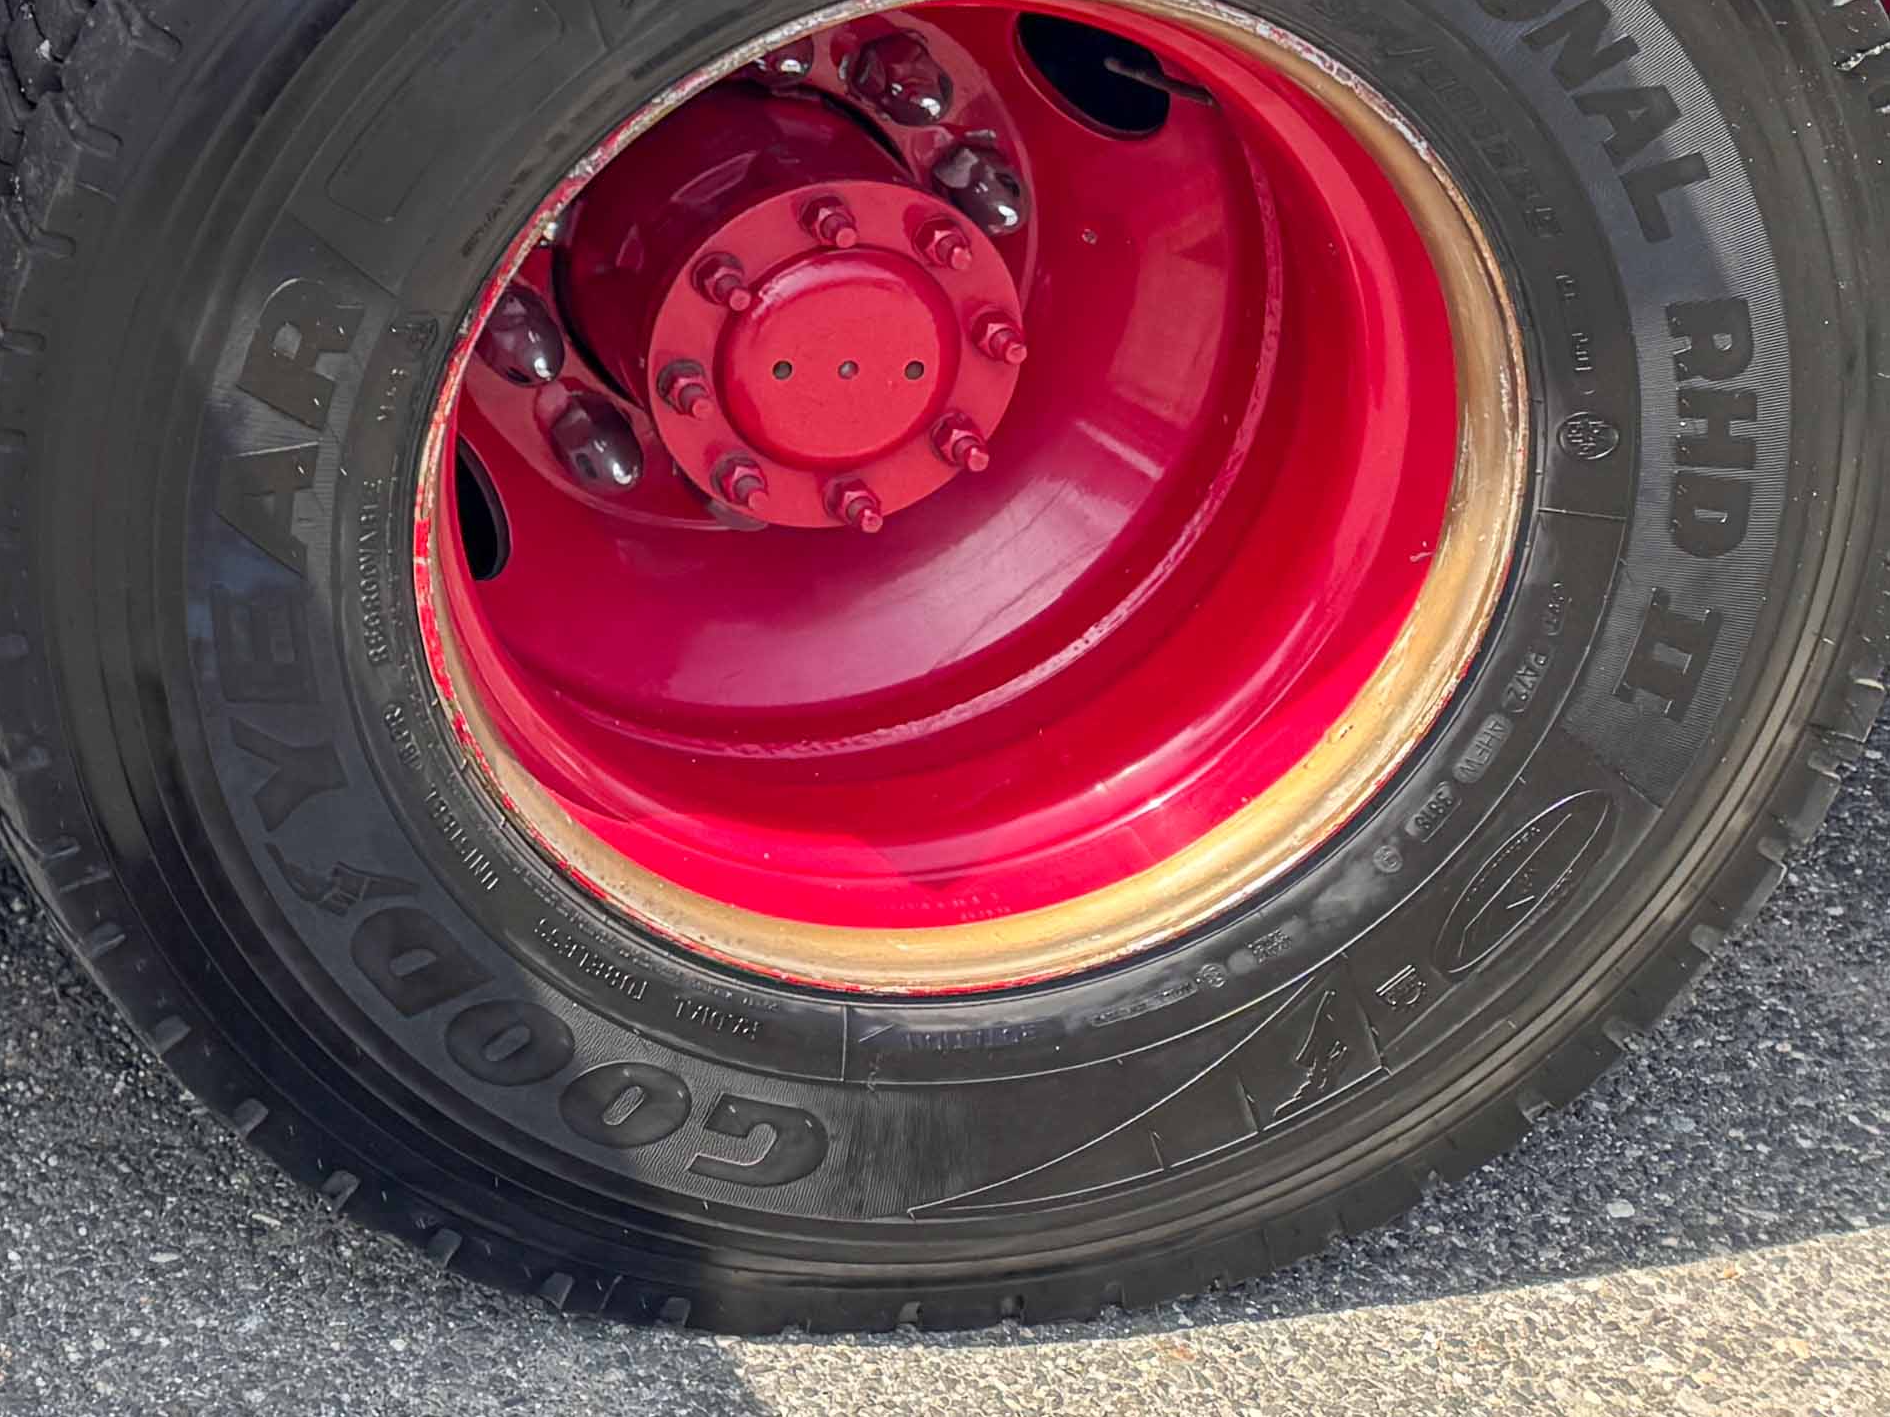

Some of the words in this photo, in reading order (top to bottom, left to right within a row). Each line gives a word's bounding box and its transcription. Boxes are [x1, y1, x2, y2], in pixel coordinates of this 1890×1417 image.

[1665, 296, 1758, 558] RHD
[212, 276, 831, 1188] GOODYEAR
[1613, 586, 1723, 723] II
